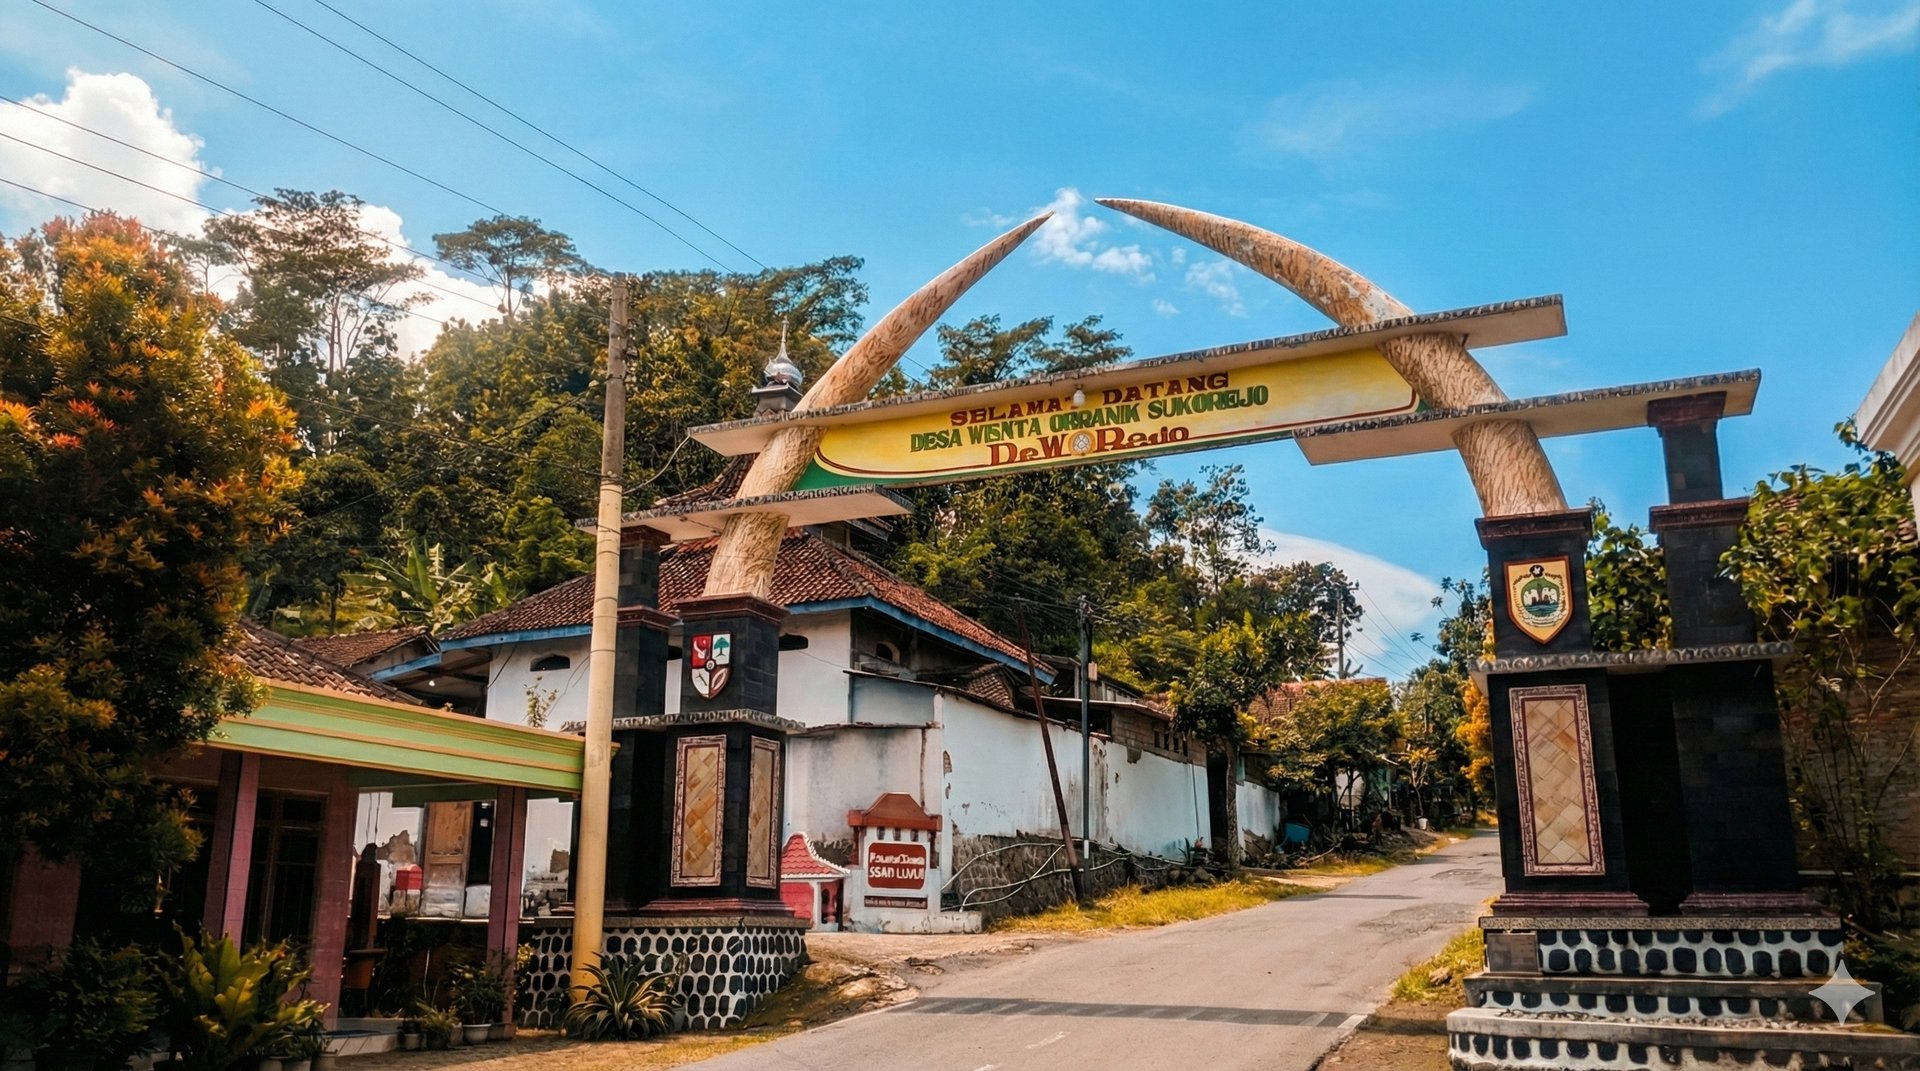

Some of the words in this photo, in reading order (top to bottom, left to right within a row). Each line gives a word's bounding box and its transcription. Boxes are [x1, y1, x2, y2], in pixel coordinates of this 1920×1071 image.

[1102, 372, 1229, 405] DATANG
[910, 429, 962, 452] DESA
[1147, 385, 1269, 420] SUKOREJO
